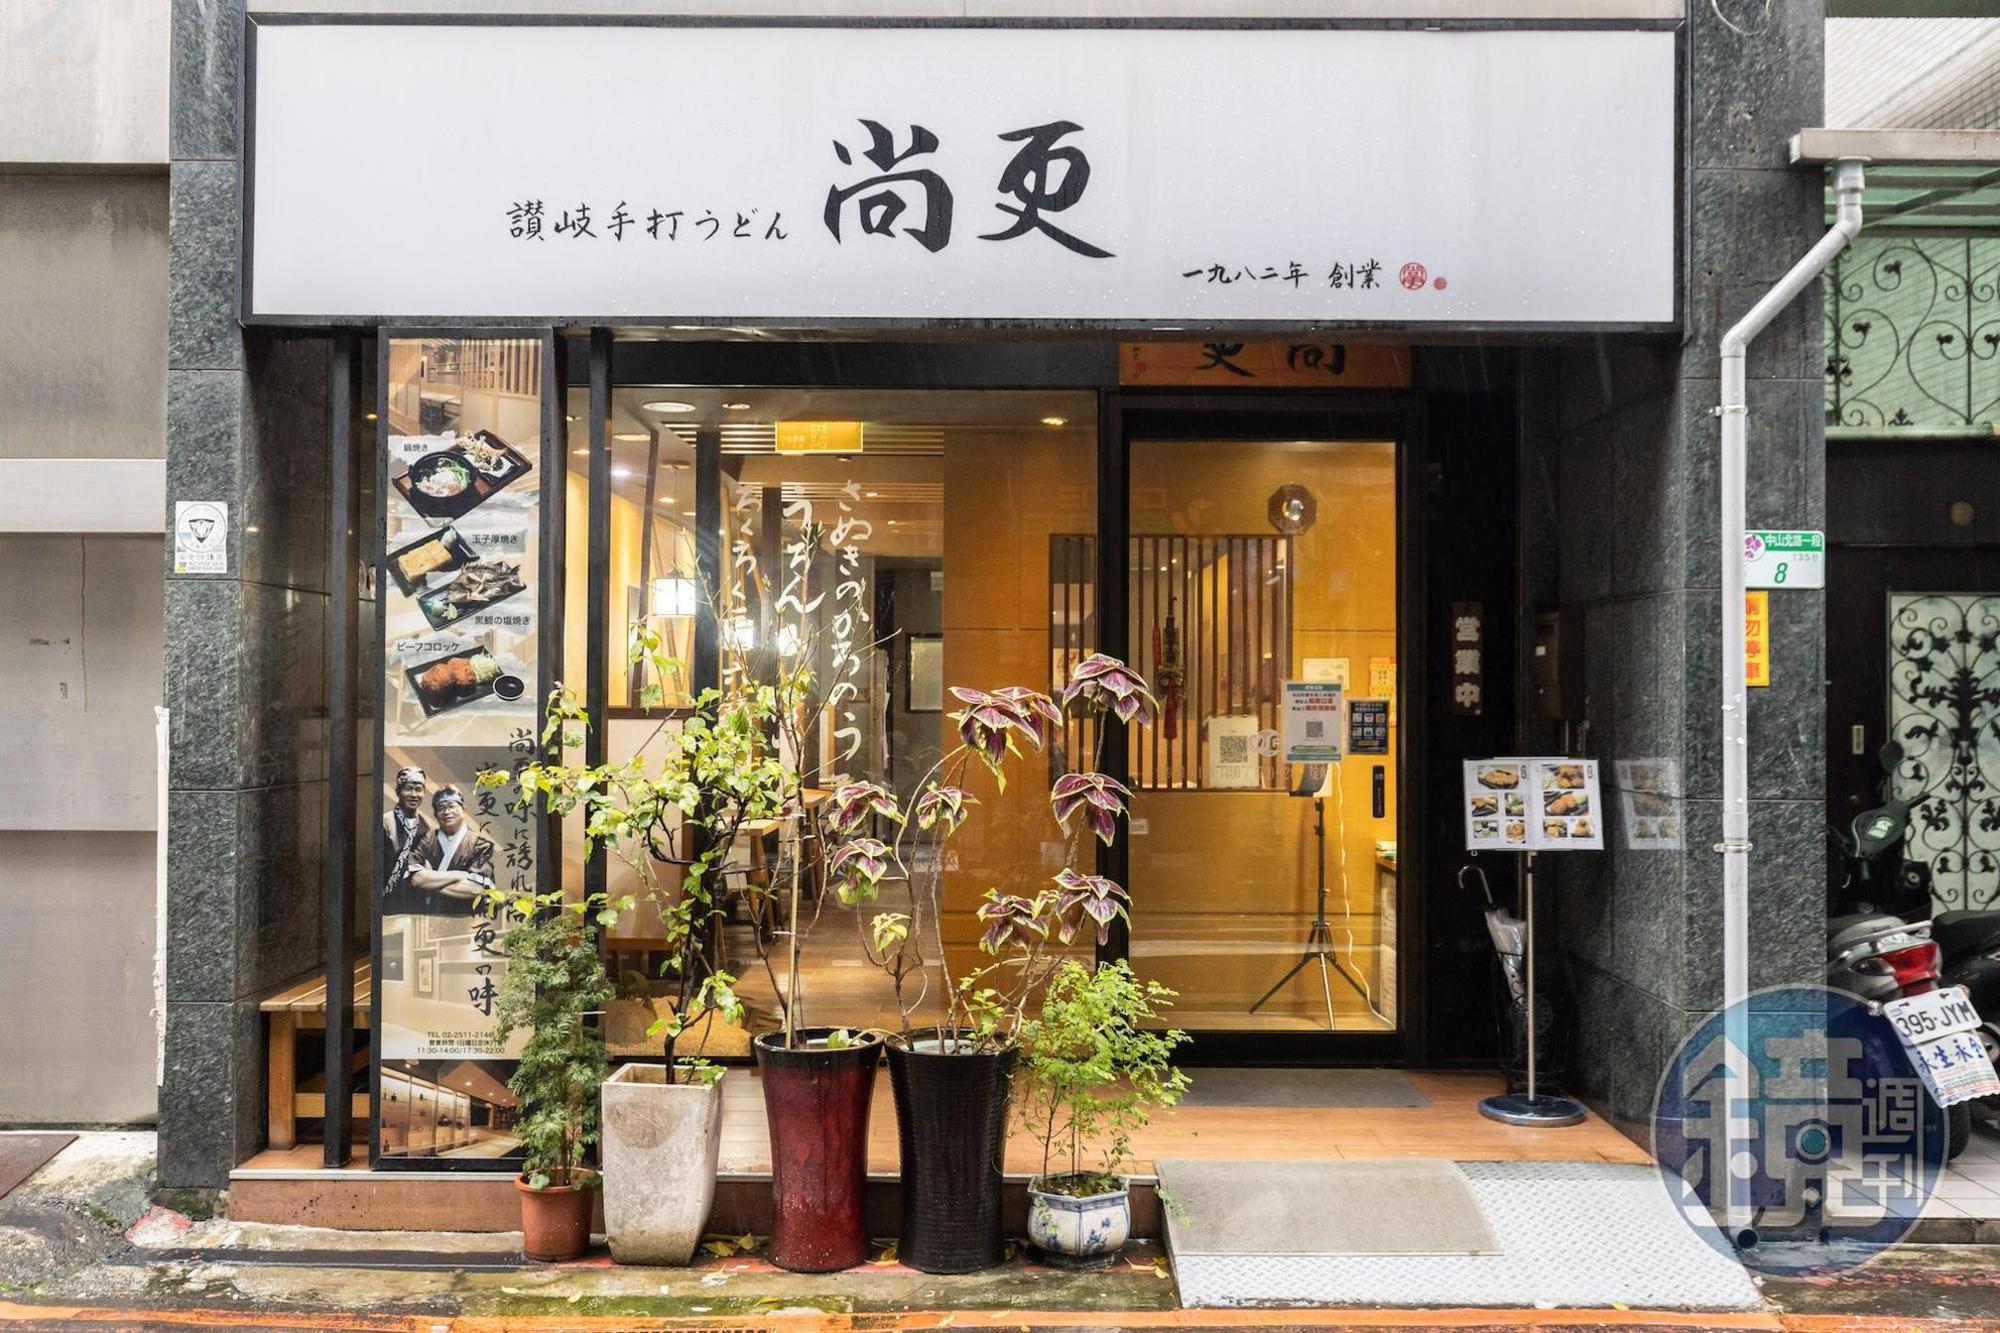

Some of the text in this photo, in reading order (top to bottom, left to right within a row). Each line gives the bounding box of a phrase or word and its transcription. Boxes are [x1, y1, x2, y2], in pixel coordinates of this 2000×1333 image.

[824, 118, 1116, 258] 尚更
[1182, 258, 1383, 289] 一九八二年 創業
[1764, 533, 1821, 547] 中山北路一段
[1774, 562, 1788, 584] 8
[397, 641, 460, 652] ビーフコロッケ
